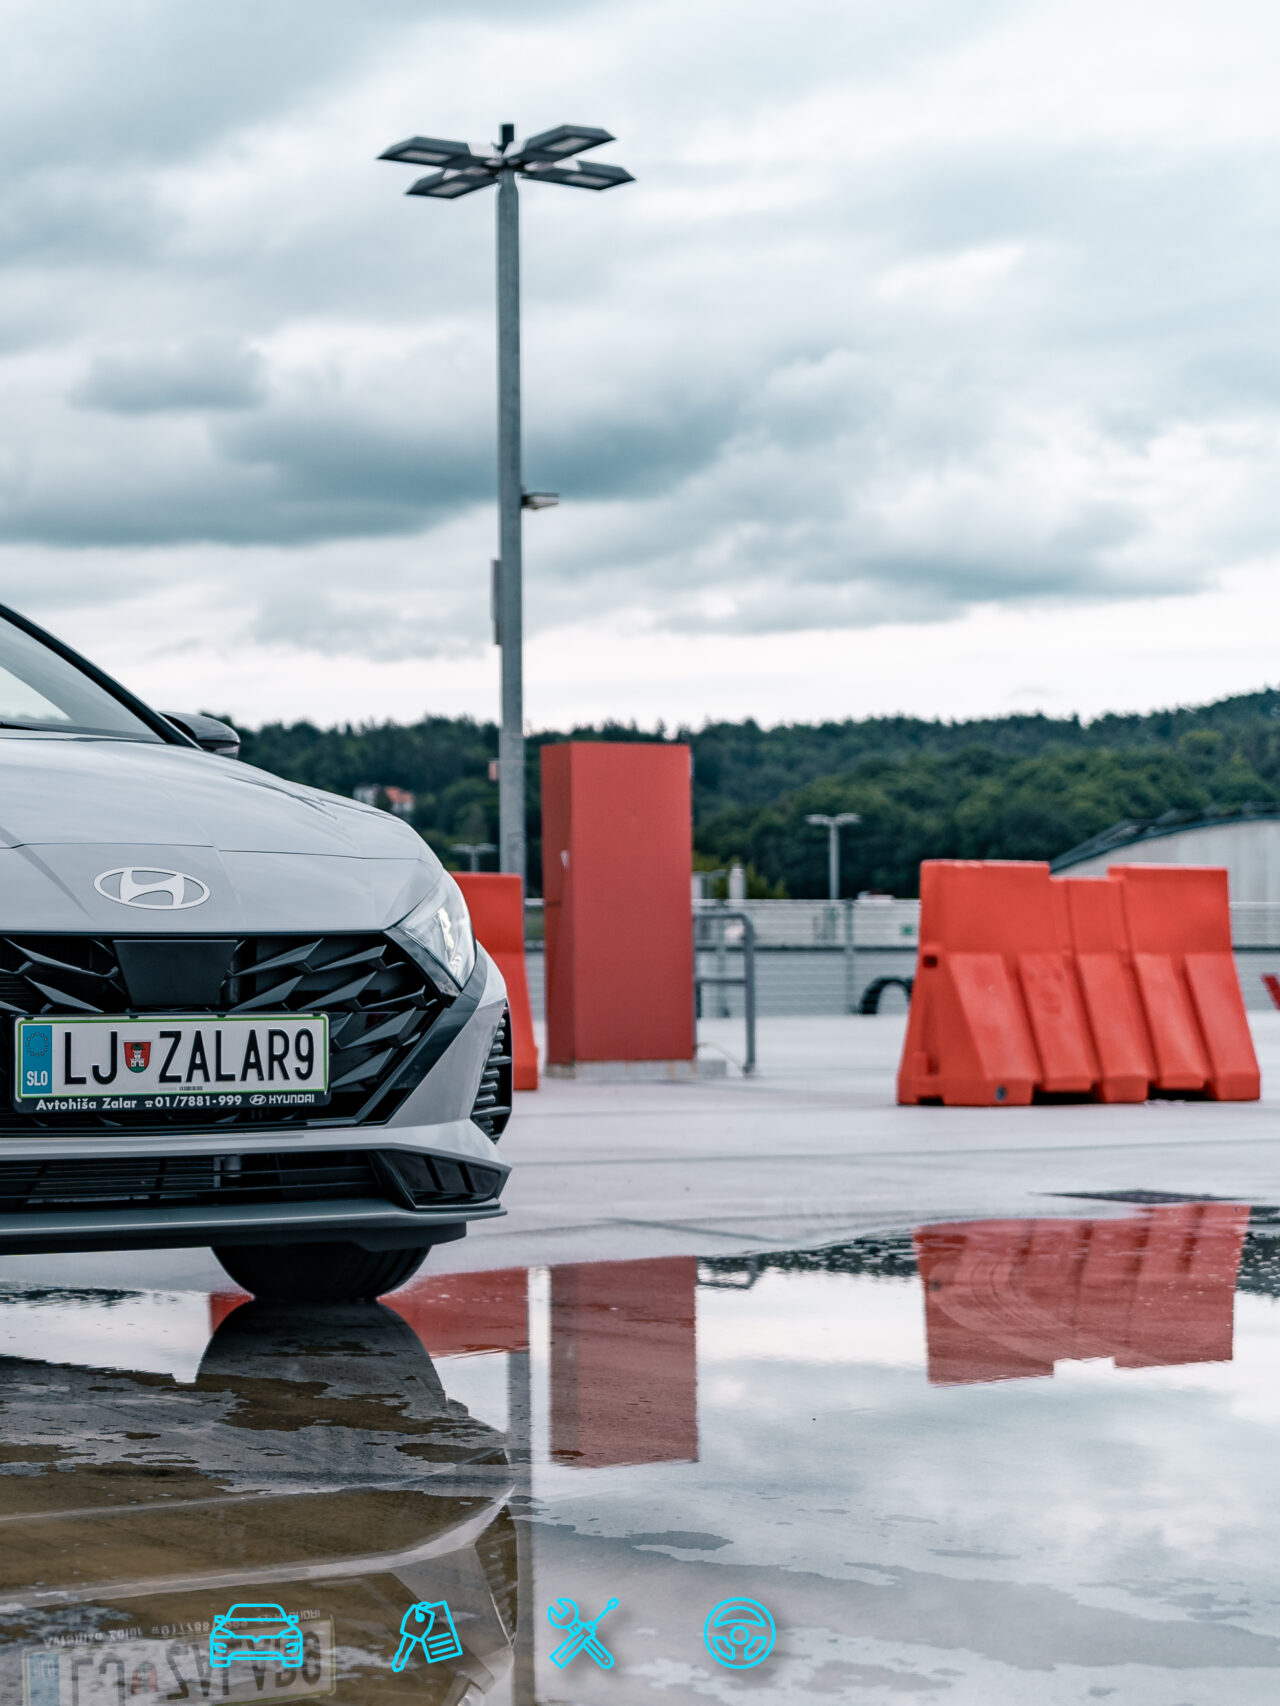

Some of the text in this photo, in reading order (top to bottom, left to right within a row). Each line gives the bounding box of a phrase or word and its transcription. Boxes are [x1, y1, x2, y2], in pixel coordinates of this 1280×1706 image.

[64, 1027, 314, 1085] LJ ZALAR9
[26, 1070, 49, 1086] SLO
[36, 1094, 315, 1111] Avtohiša Zalar 01/7881-999 HYUNDAI
